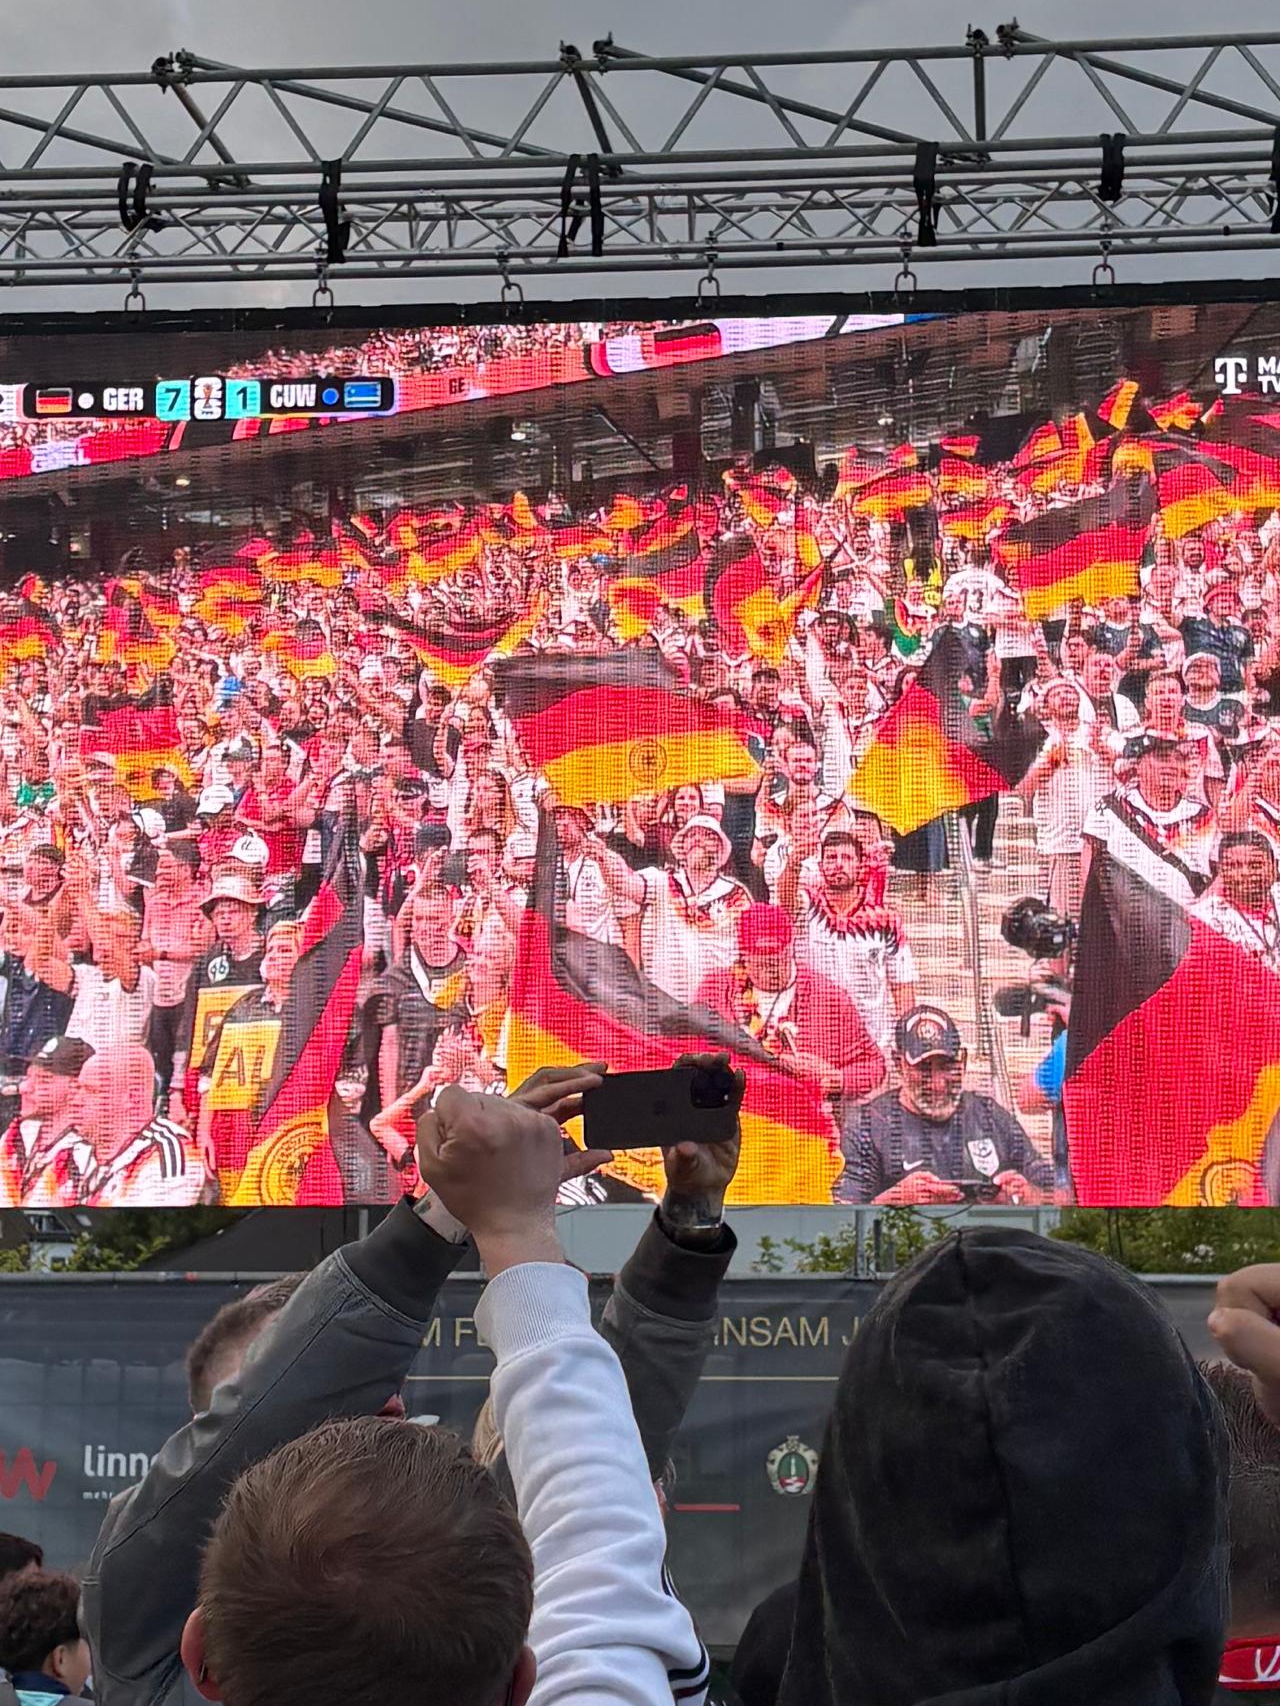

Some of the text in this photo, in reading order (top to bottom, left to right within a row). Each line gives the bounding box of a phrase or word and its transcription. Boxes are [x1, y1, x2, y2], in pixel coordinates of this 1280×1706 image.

[103, 387, 144, 412] GER
[165, 387, 181, 411] 7
[236, 385, 249, 410] 1
[270, 384, 317, 408] CUW
[714, 1316, 829, 1346] NSAM
